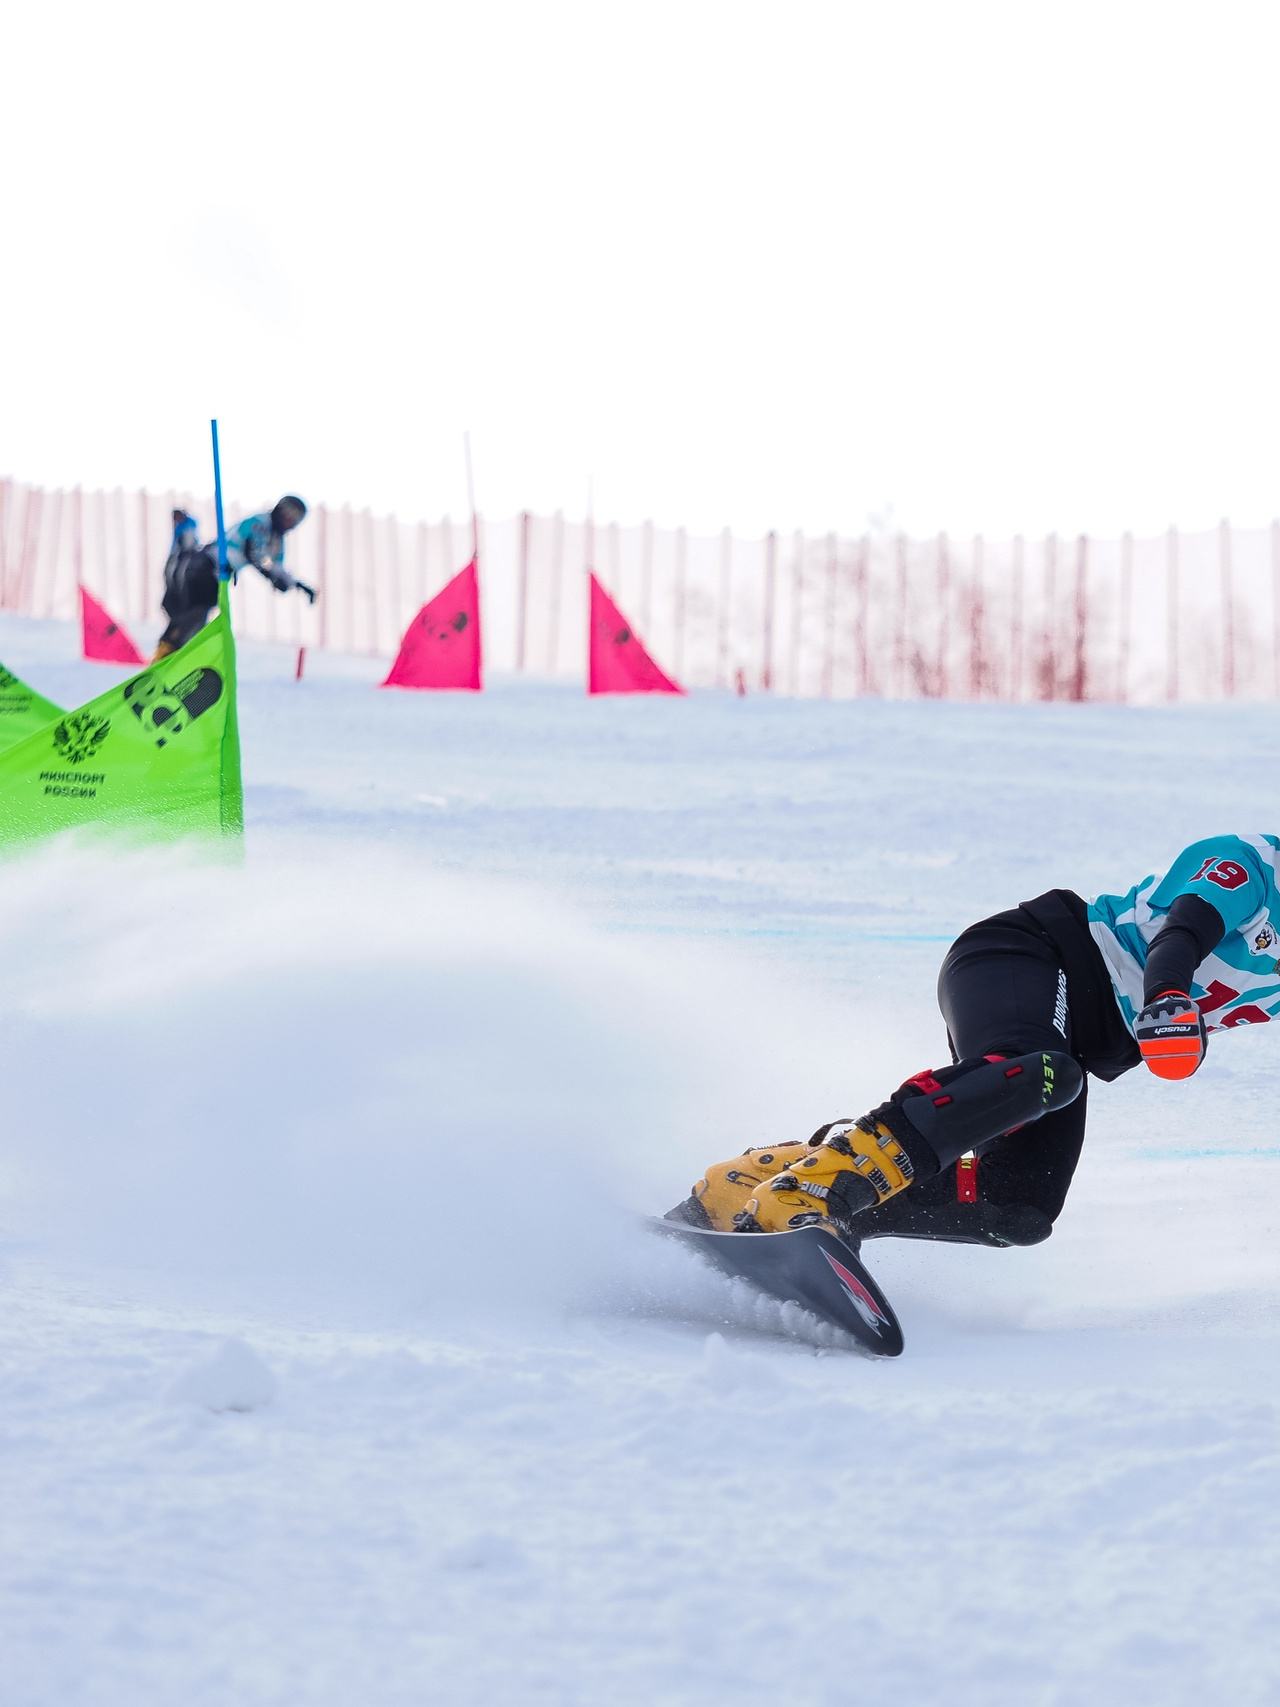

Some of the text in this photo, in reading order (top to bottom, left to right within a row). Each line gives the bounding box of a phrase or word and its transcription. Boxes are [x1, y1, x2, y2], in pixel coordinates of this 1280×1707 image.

[39, 771, 106, 785] МИНСПОРТ
[44, 785, 97, 798] РОССИИ
[1188, 856, 1249, 891] 19
[1154, 1025, 1191, 1035] reusch
